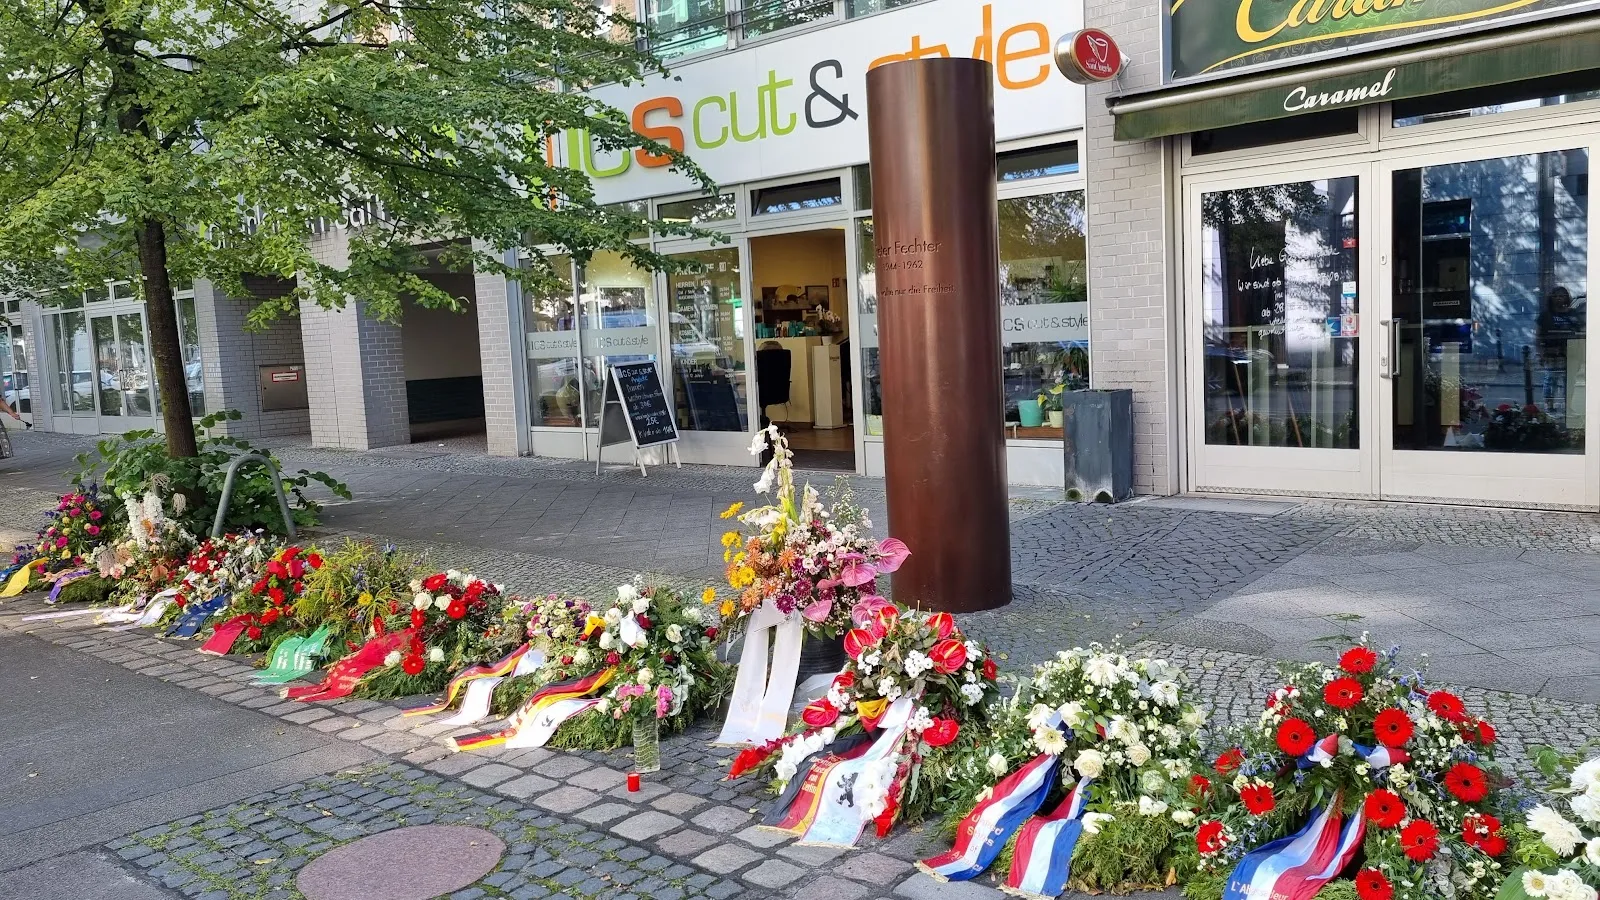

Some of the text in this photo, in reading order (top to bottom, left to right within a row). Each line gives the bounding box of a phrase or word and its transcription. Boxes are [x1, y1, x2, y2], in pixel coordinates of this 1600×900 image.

[693, 70, 797, 150] cut
[804, 59, 859, 129] &
[1283, 67, 1397, 112] Caramel
[894, 238, 942, 255] Fechter
[908, 285, 921, 295] die
